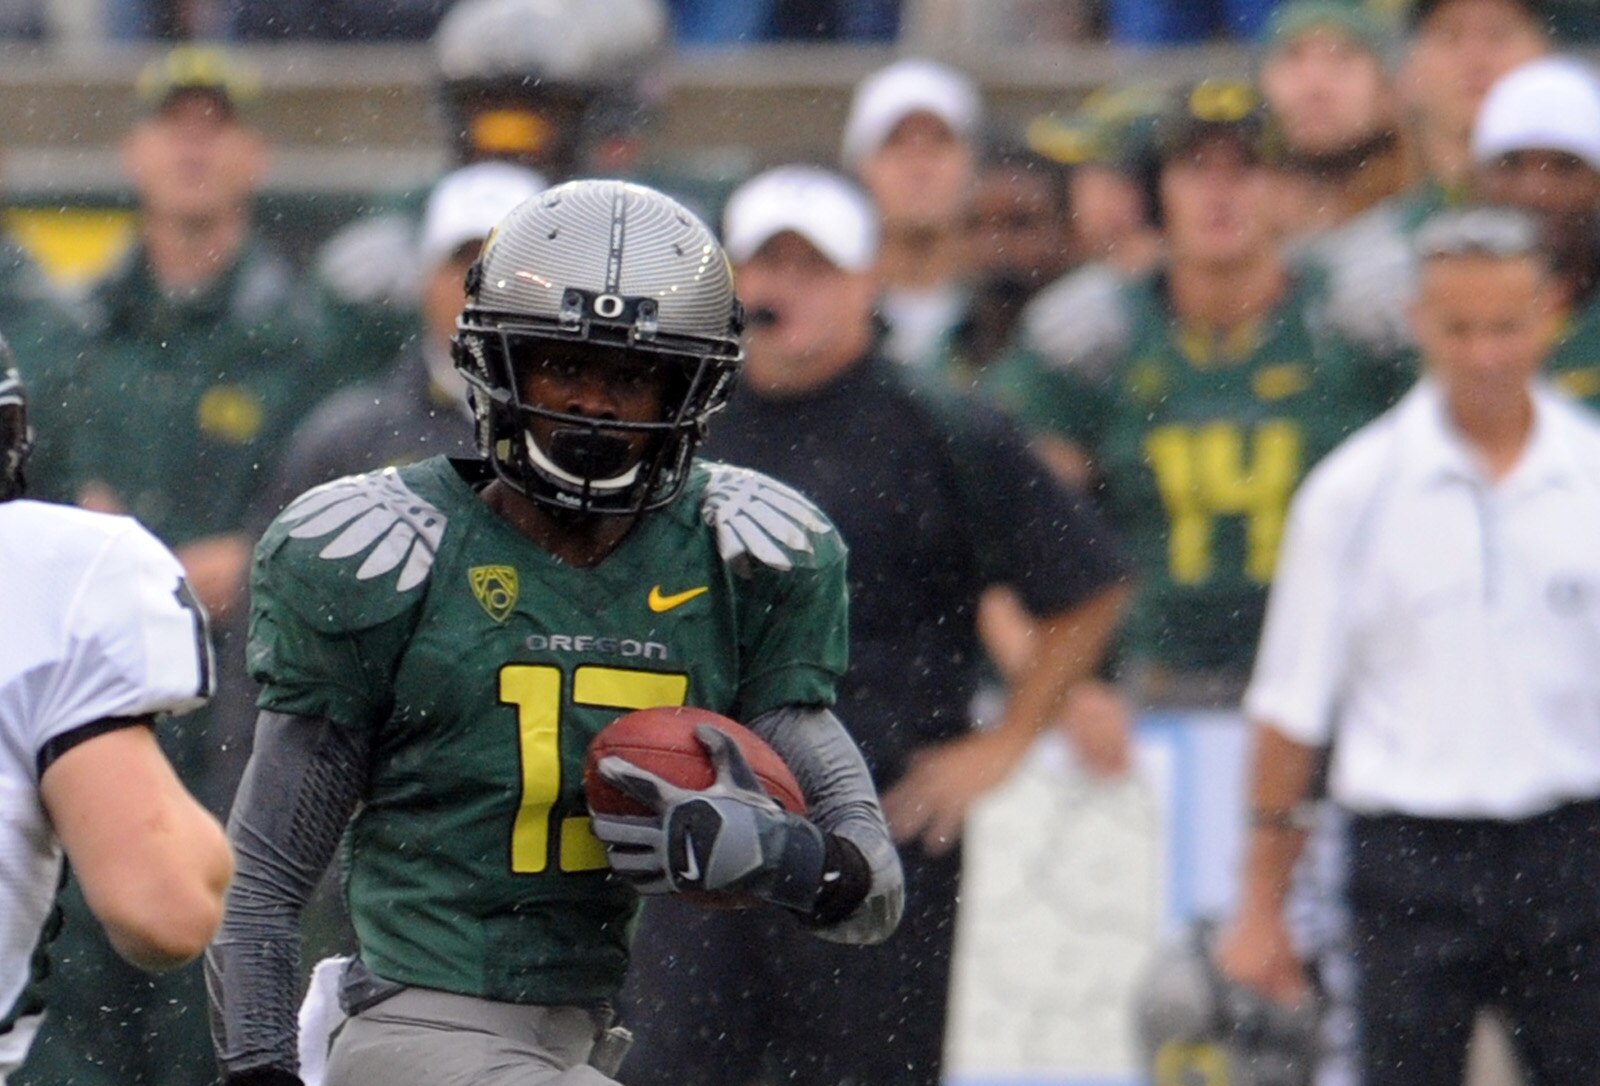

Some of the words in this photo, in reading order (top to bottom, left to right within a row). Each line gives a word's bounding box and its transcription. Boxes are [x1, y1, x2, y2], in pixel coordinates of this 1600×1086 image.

[594, 294, 624, 318] O
[1148, 422, 1300, 585] 14
[525, 634, 668, 661] OREGON
